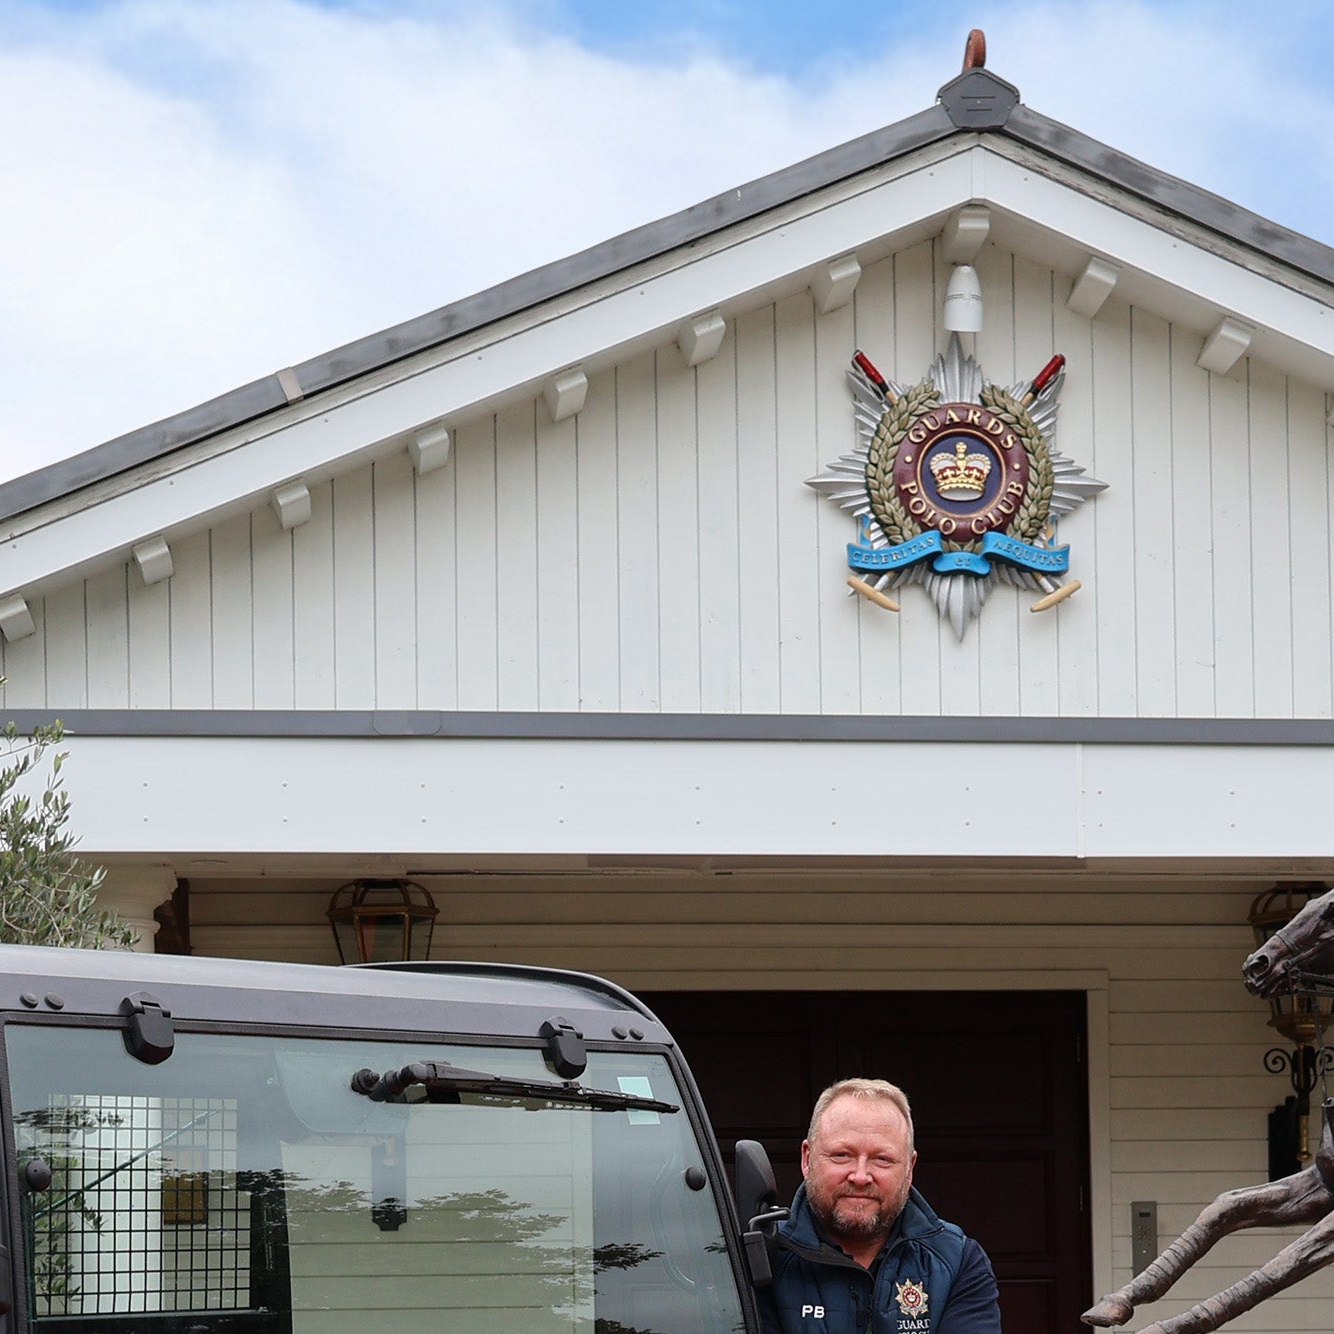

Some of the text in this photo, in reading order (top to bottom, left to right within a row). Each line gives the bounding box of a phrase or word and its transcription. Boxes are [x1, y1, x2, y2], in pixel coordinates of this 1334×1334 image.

[909, 409, 1016, 449] GUARDS
[901, 481, 1024, 535] POLO CLUB
[852, 536, 934, 564] CELERITAS
[802, 1305, 825, 1318] PB
